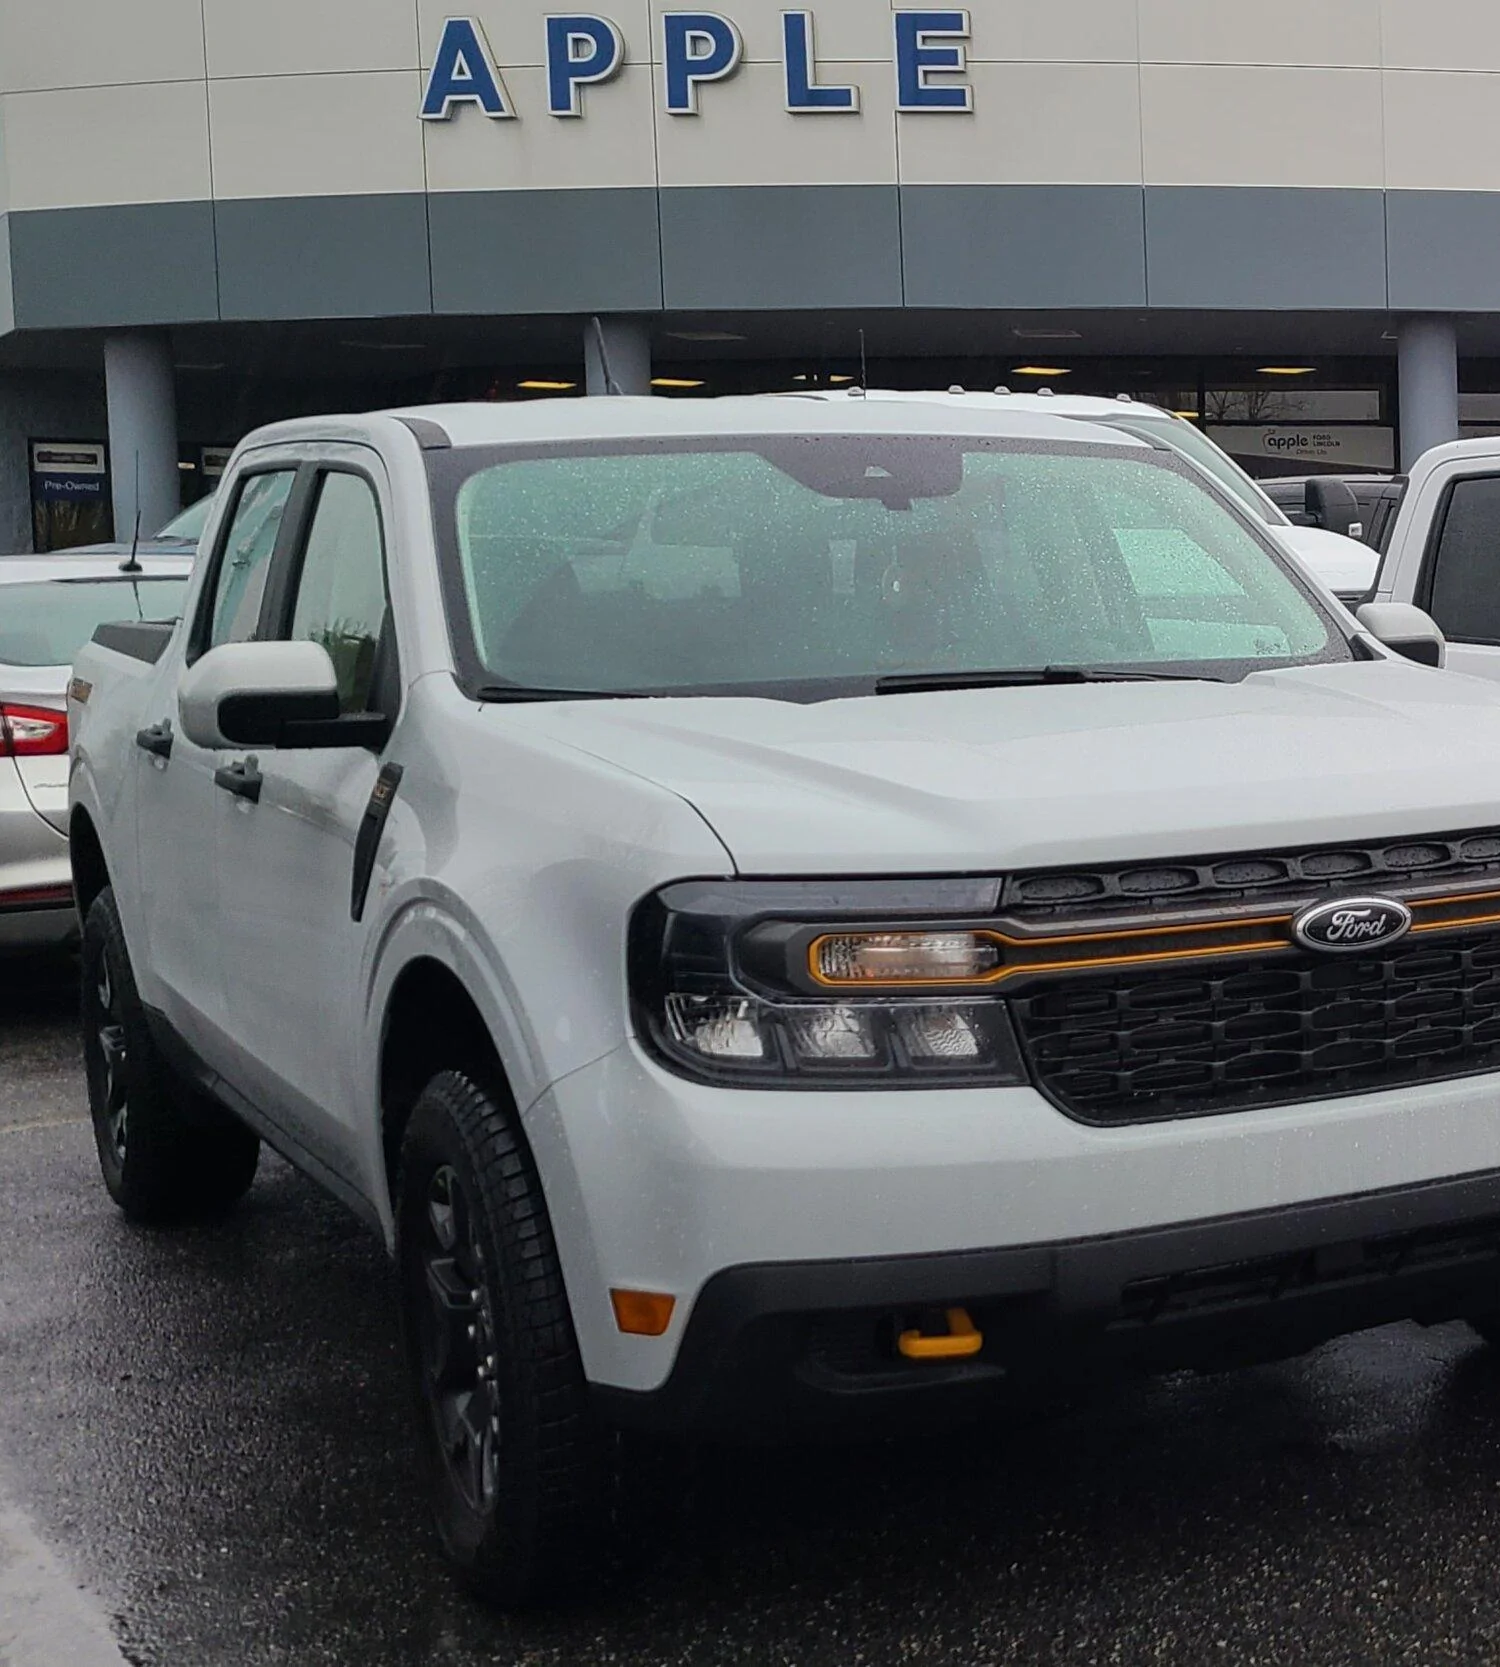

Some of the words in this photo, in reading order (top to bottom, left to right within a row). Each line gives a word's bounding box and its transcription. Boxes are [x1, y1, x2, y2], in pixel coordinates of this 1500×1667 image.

[418, 8, 974, 120] APPLE
[1267, 433, 1309, 450] apple
[44, 480, 100, 492] Pre-Owned
[1326, 908, 1387, 941] Ford
